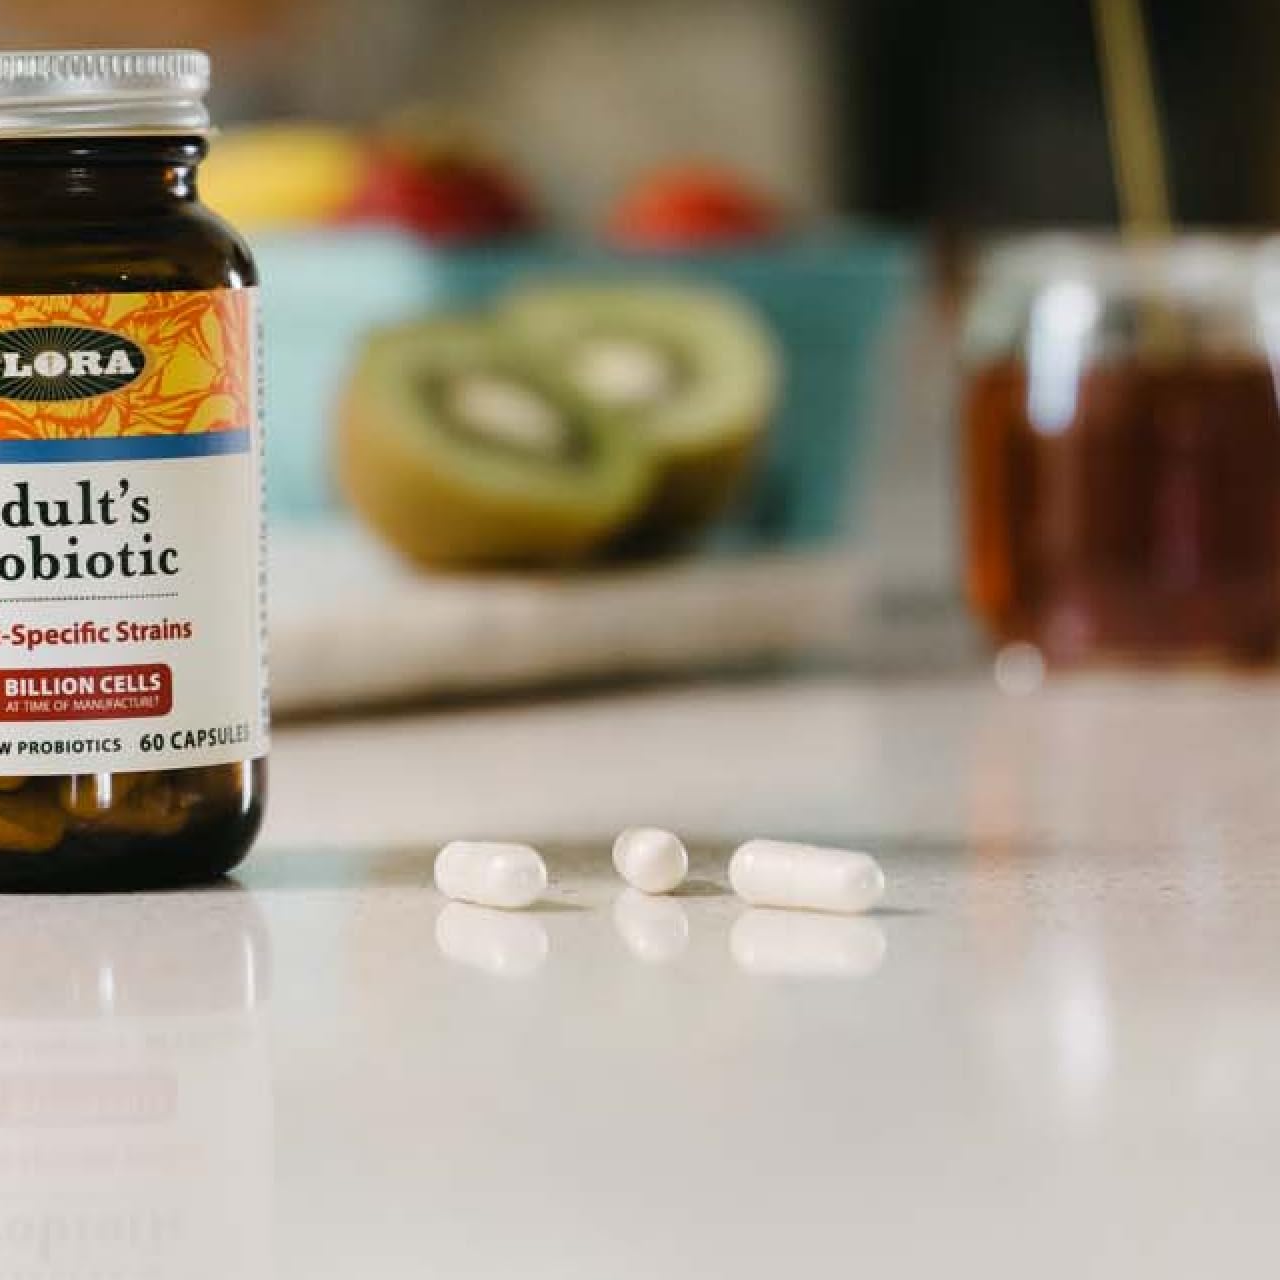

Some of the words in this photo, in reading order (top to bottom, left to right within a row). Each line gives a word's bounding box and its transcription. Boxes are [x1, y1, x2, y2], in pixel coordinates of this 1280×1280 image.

[116, 617, 193, 642] Strains
[5, 676, 95, 697] BILLION
[100, 673, 161, 694] CELLS
[5, 701, 19, 712] AT
[24, 699, 51, 712] TIME
[54, 699, 68, 712] OF
[17, 738, 122, 755] PROBIOTICS
[140, 733, 165, 752] 60
[171, 724, 250, 750] CAPSULES
